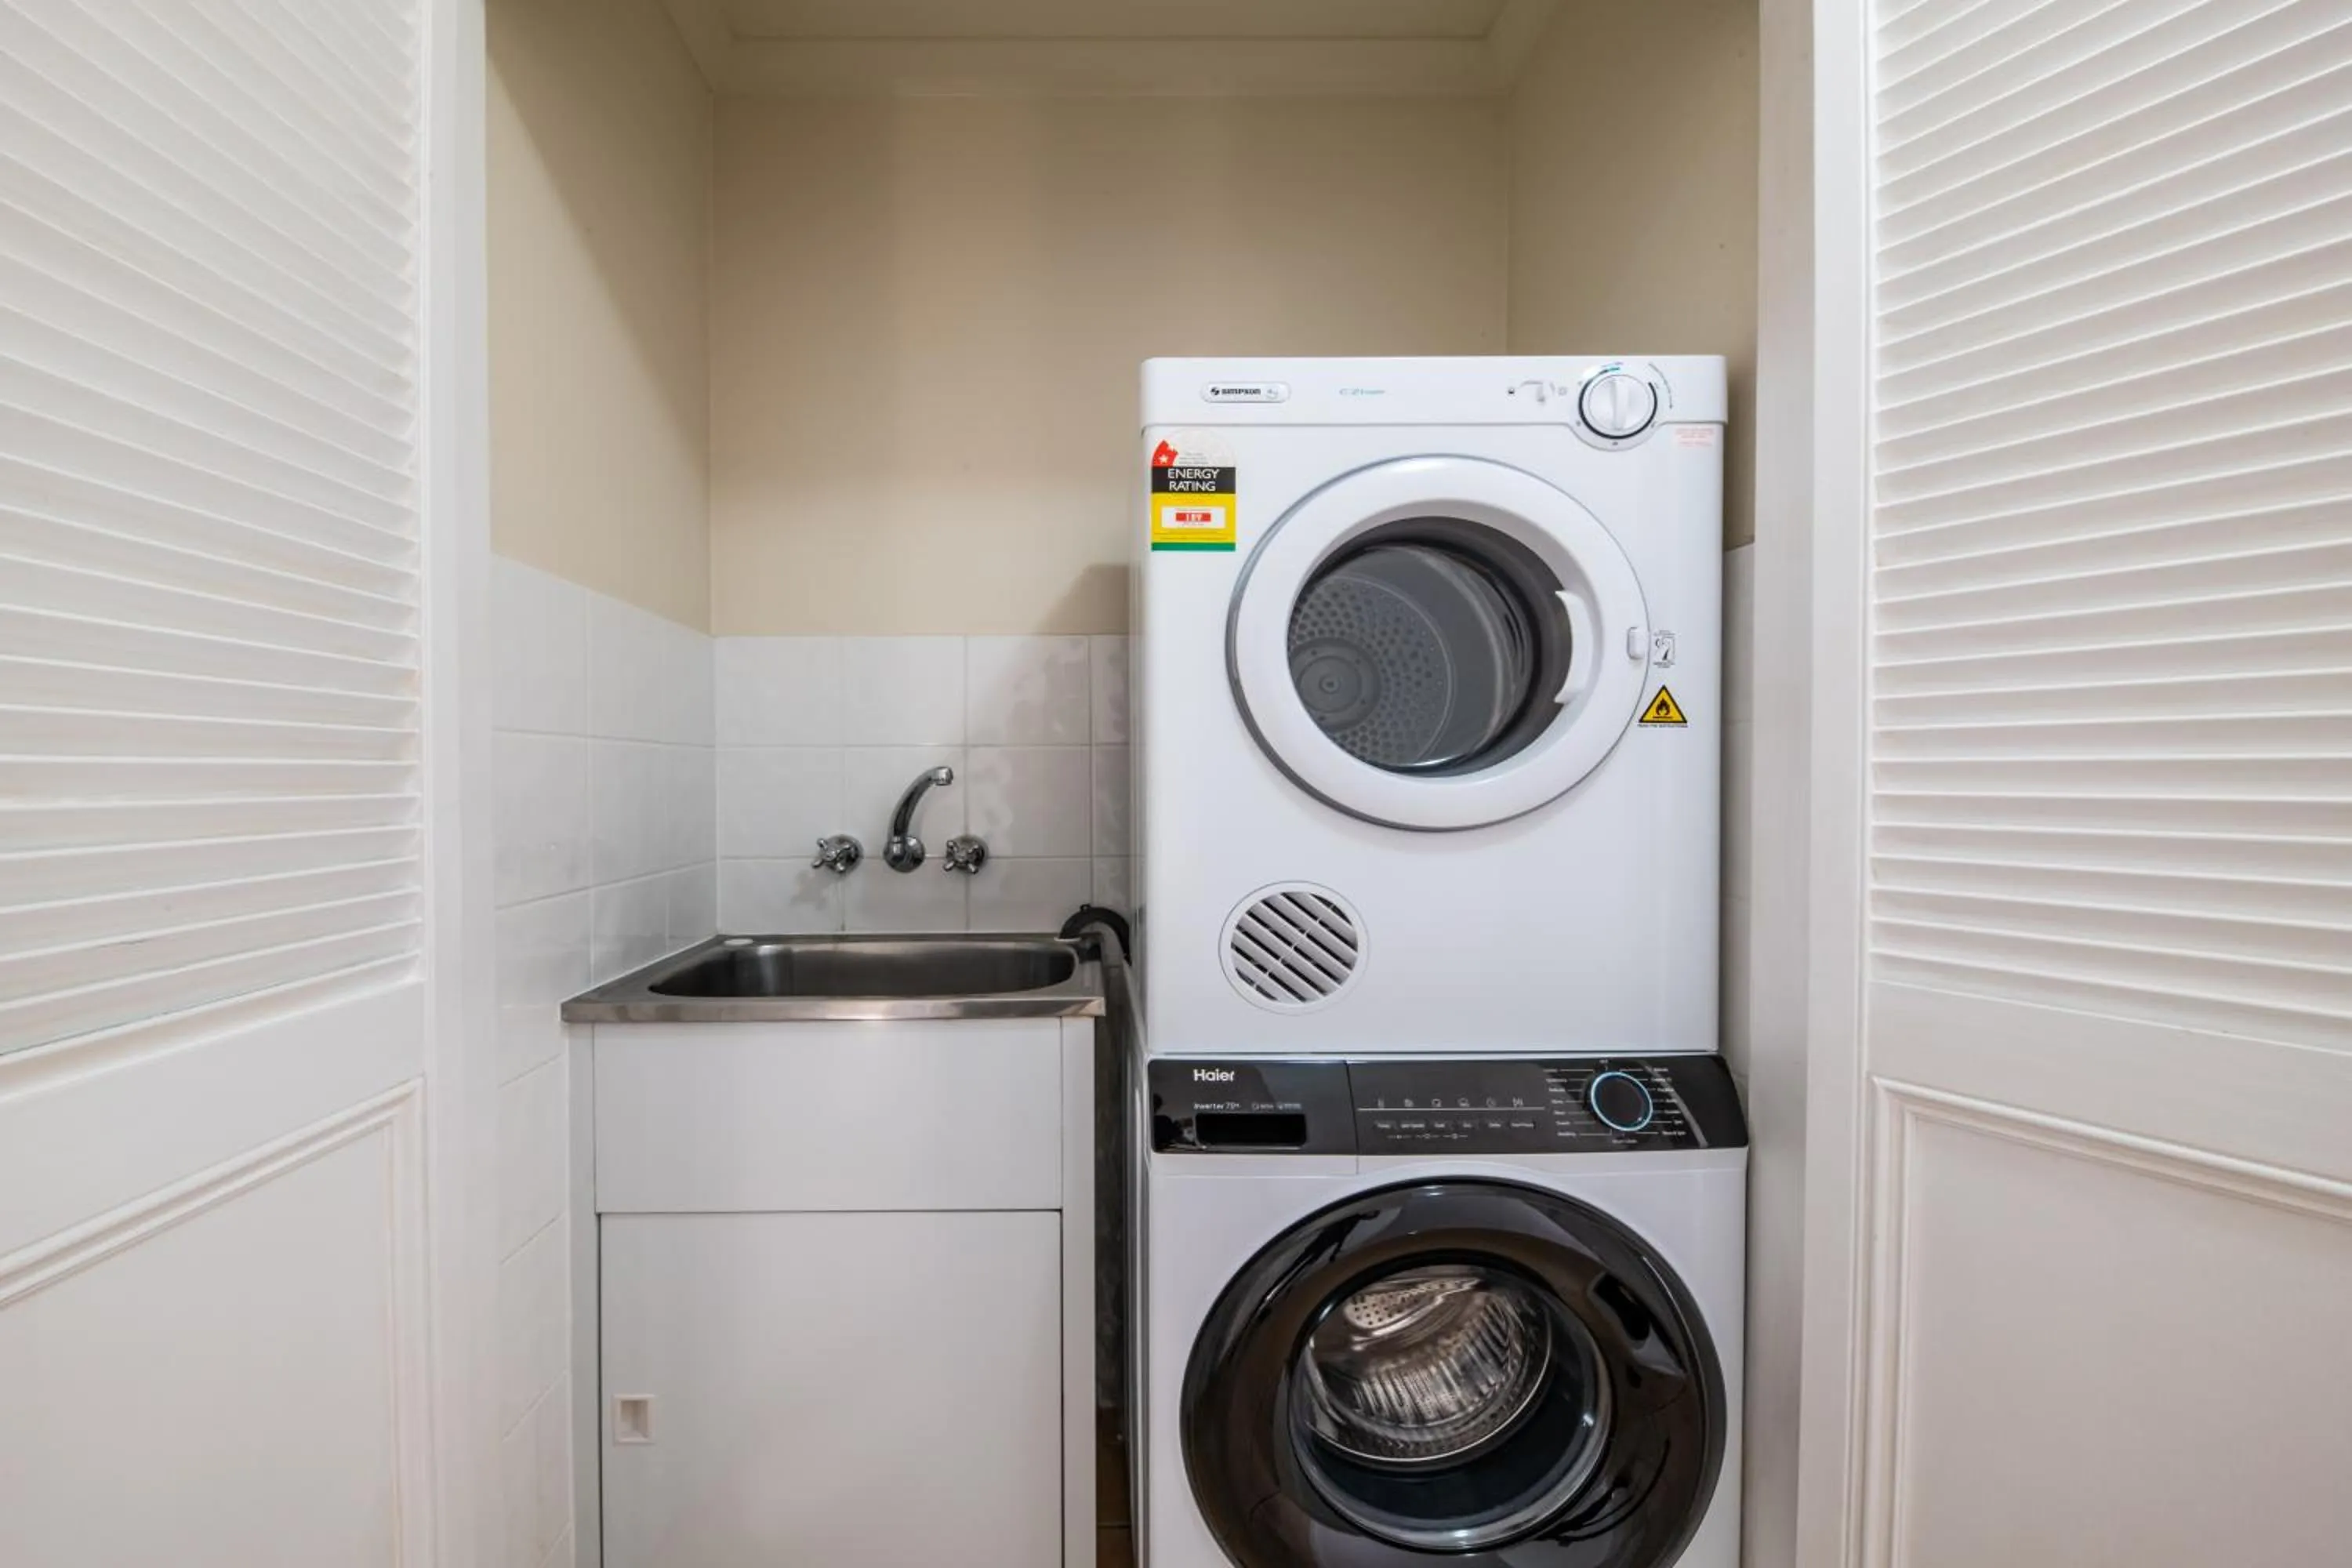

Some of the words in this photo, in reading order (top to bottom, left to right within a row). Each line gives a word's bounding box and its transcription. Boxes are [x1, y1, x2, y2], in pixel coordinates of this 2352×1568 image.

[1167, 468, 1220, 479] ENERGY
[1169, 481, 1216, 492] RATING
[1193, 1068, 1235, 1081] Haier
